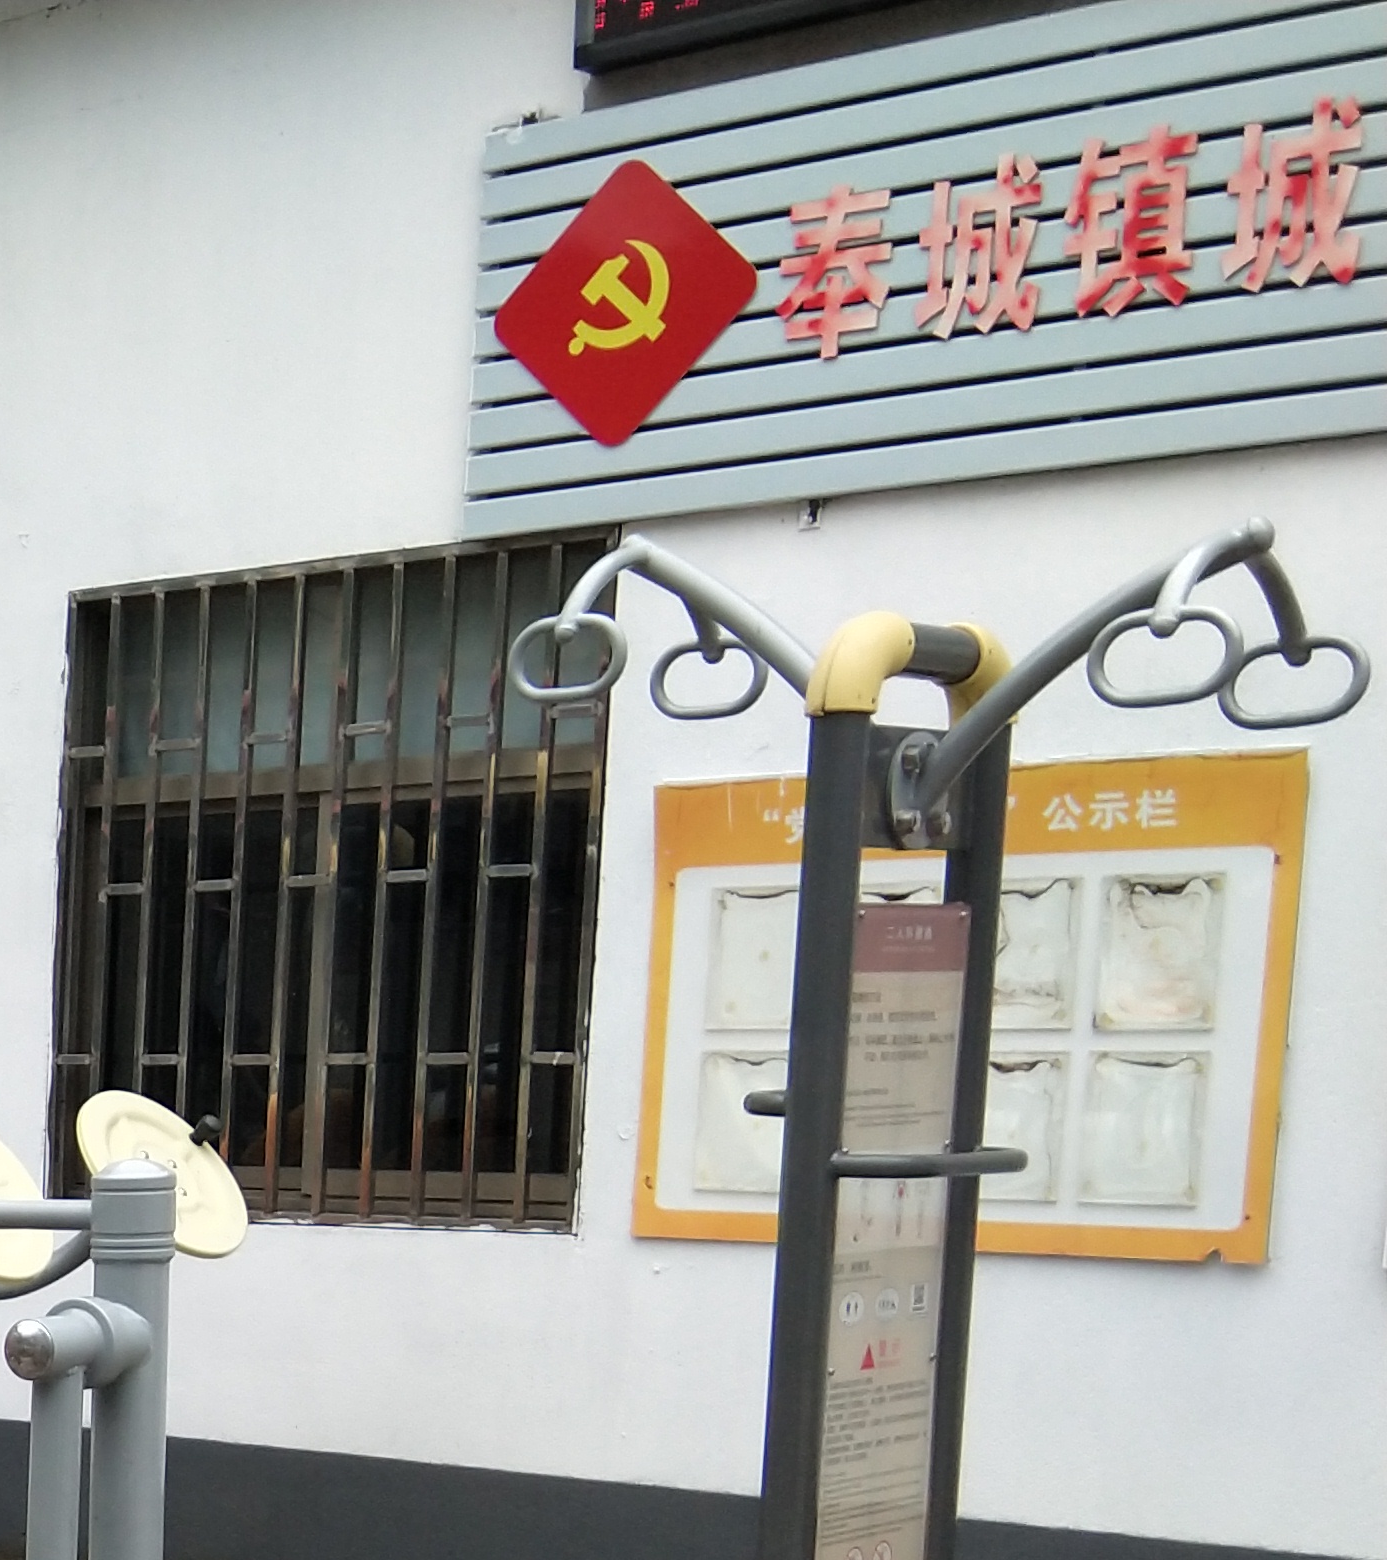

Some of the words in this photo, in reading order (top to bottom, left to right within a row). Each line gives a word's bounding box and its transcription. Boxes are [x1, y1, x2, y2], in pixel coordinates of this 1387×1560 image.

[777, 94, 1365, 361] 奉城镇城
[1042, 787, 1178, 832] 公示栏
